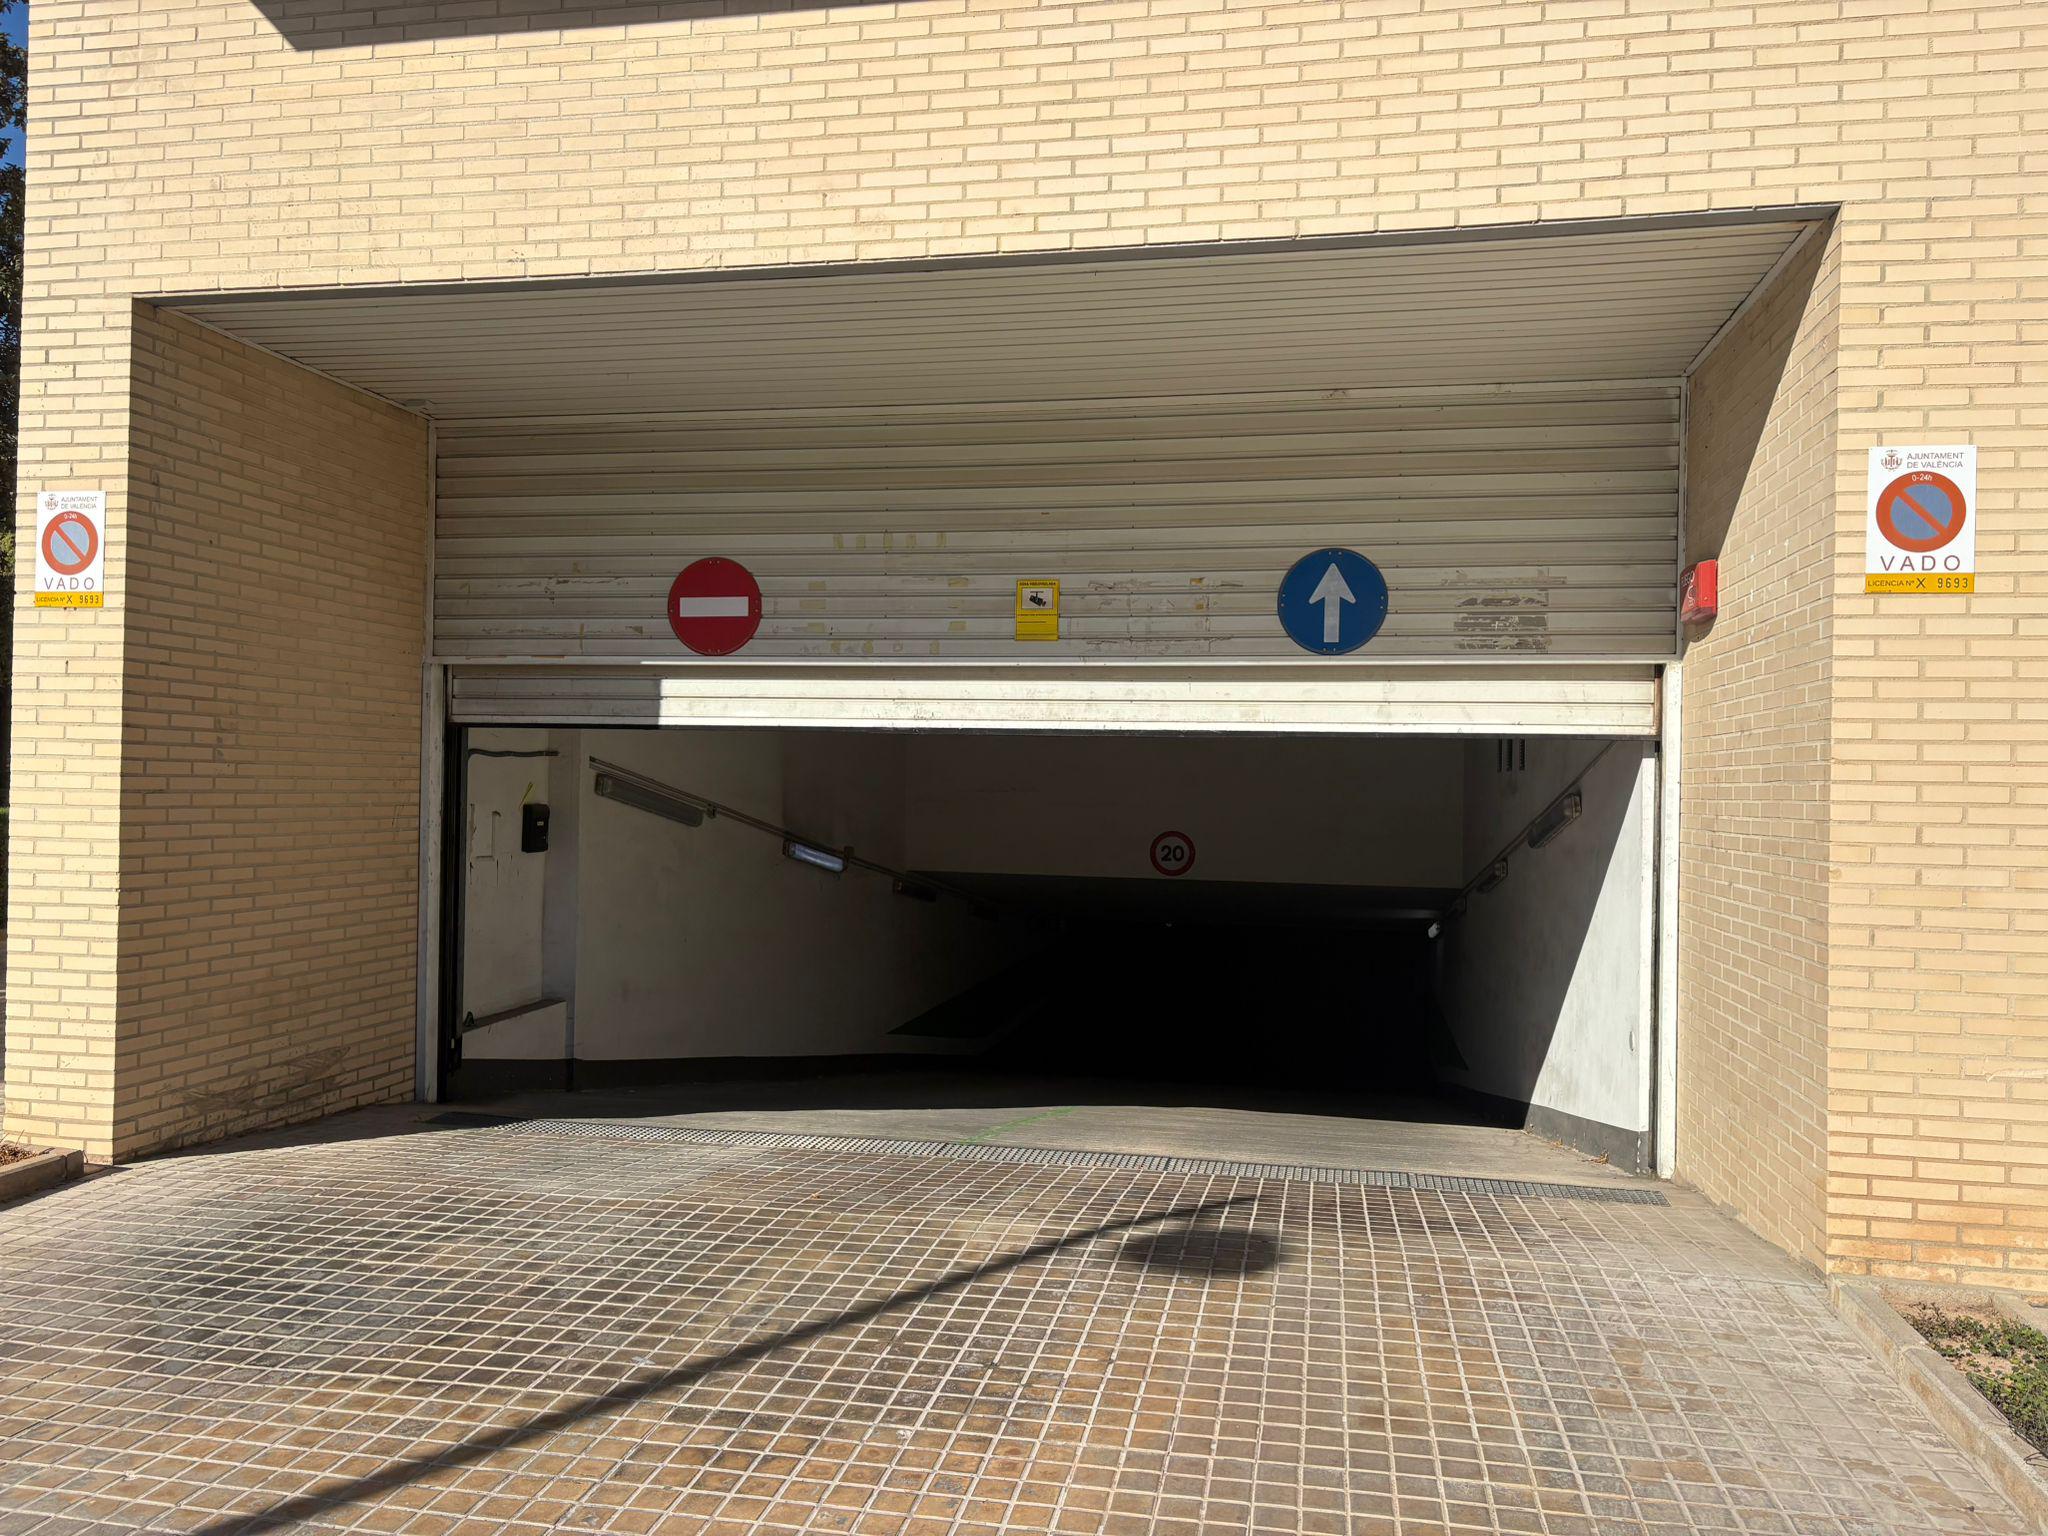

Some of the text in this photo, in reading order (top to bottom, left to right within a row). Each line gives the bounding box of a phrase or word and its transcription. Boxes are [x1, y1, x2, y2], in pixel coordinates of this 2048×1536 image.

[1907, 452, 1965, 460] AJUNTAMENT
[1906, 461, 1919, 469] DE
[1911, 473, 1933, 482] 0-24h
[1880, 555, 1961, 571] VADO
[44, 577, 95, 590] VADO
[1867, 579, 1905, 587] LICENCIA
[1916, 577, 1927, 588] X
[1937, 577, 1969, 588] 9693
[66, 595, 73, 604] X
[79, 595, 99, 604] 9693
[1161, 845, 1184, 861] 20
